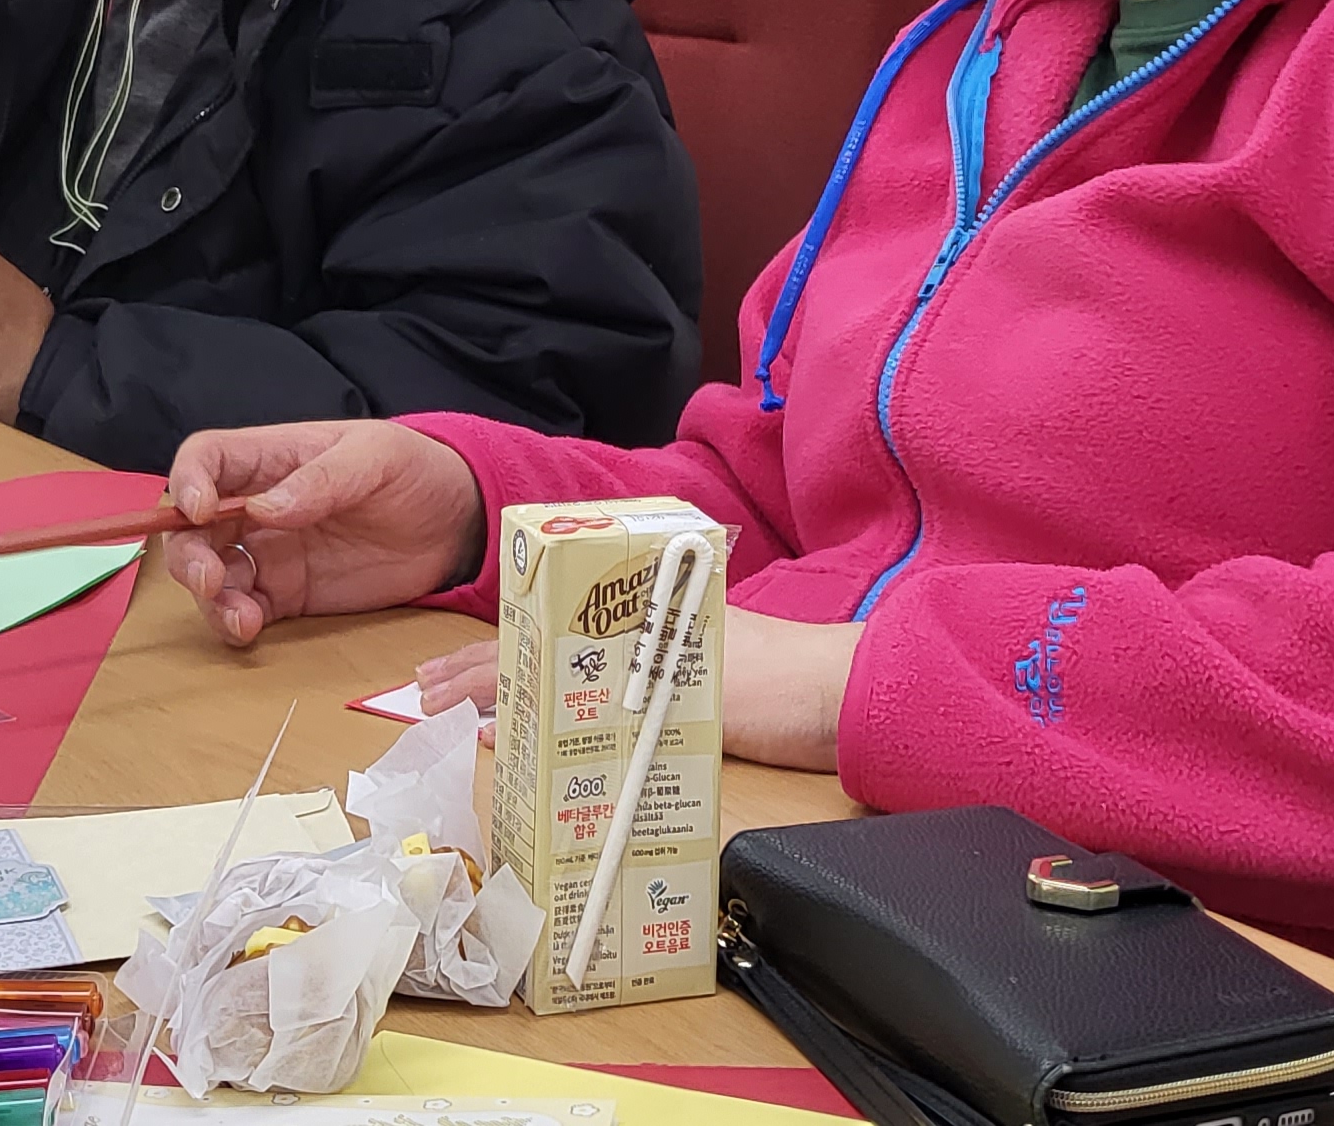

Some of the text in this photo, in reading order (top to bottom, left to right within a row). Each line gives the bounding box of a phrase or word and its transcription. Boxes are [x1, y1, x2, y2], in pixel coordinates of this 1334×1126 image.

[592, 591, 641, 642] Oat
[563, 688, 611, 708] 핀란드산
[575, 707, 598, 722] 오트
[568, 776, 604, 800] 600
[557, 803, 616, 824] 베타글루칸
[653, 799, 702, 812] beta-glucan
[574, 823, 598, 840] 함유
[554, 879, 578, 892] Vegan
[647, 884, 688, 914] Vegan
[642, 919, 692, 938] 비건인증
[642, 937, 691, 955] 오트음료
